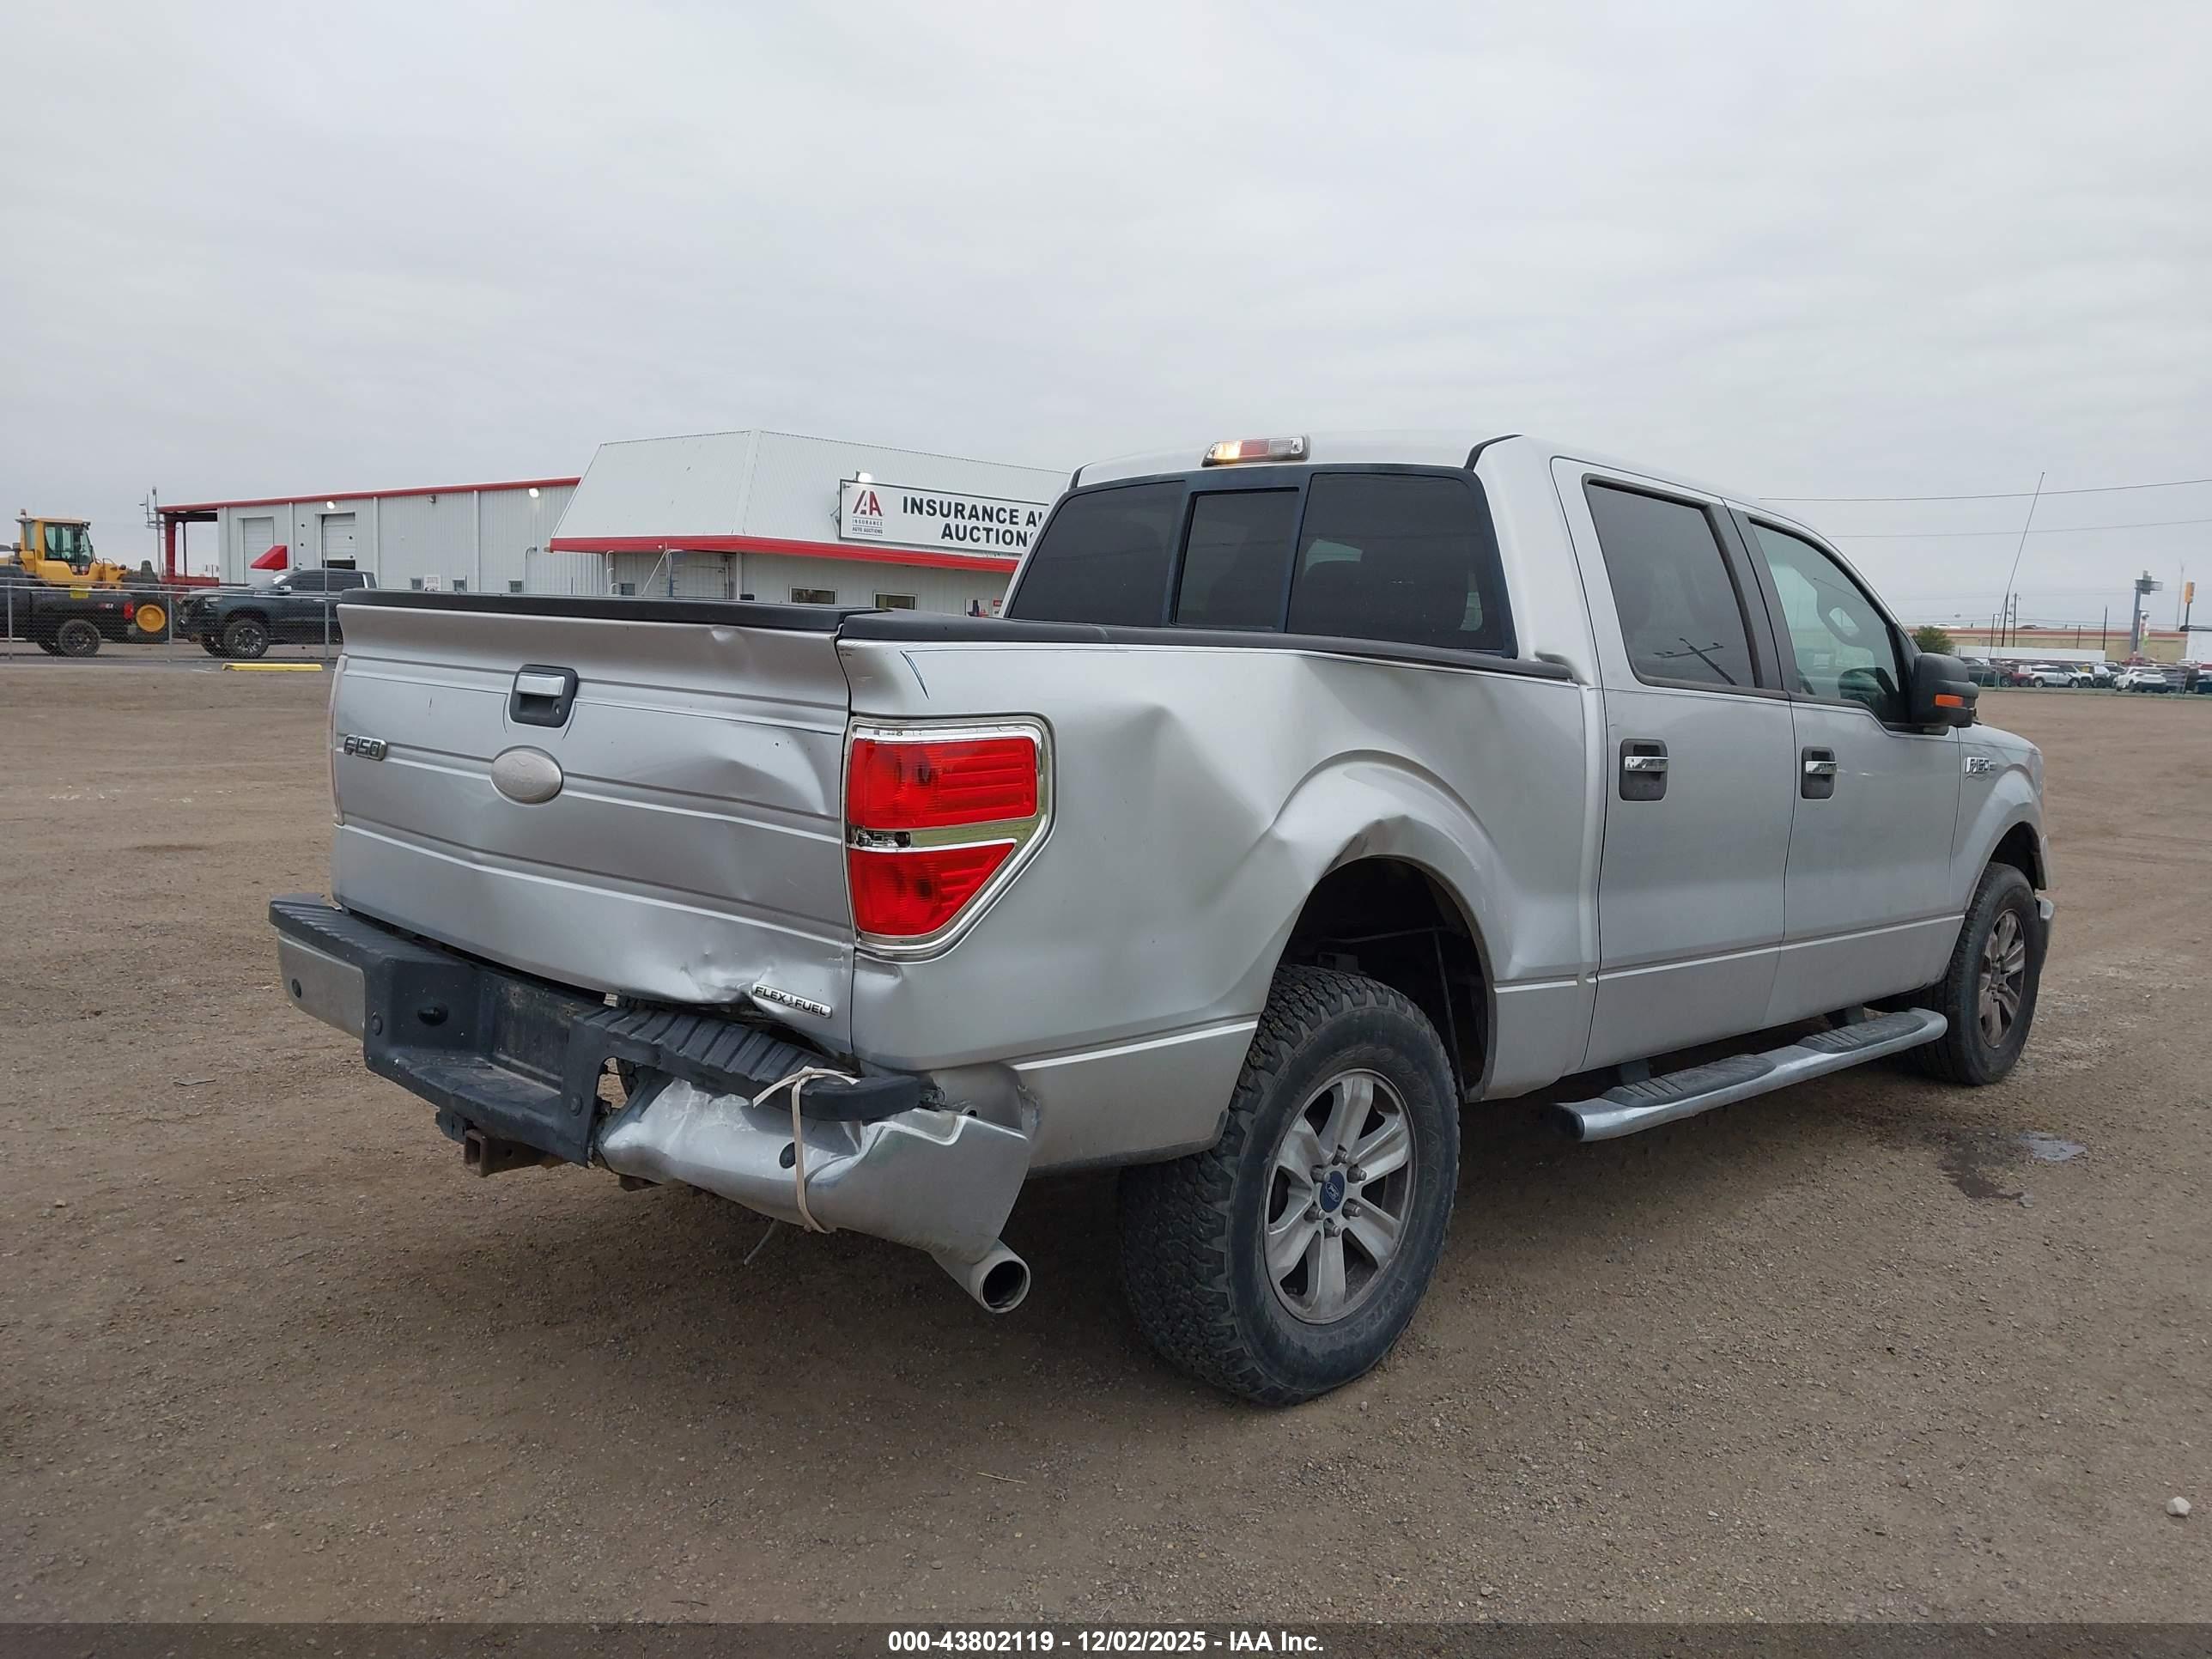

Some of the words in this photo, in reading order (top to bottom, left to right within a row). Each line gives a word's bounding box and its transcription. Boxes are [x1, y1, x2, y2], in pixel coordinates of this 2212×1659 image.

[902, 495, 1019, 526] INSURANCE
[941, 523, 1034, 547] AUCTION
[755, 987, 787, 1003] FLEX
[795, 1000, 826, 1016] FUEL
